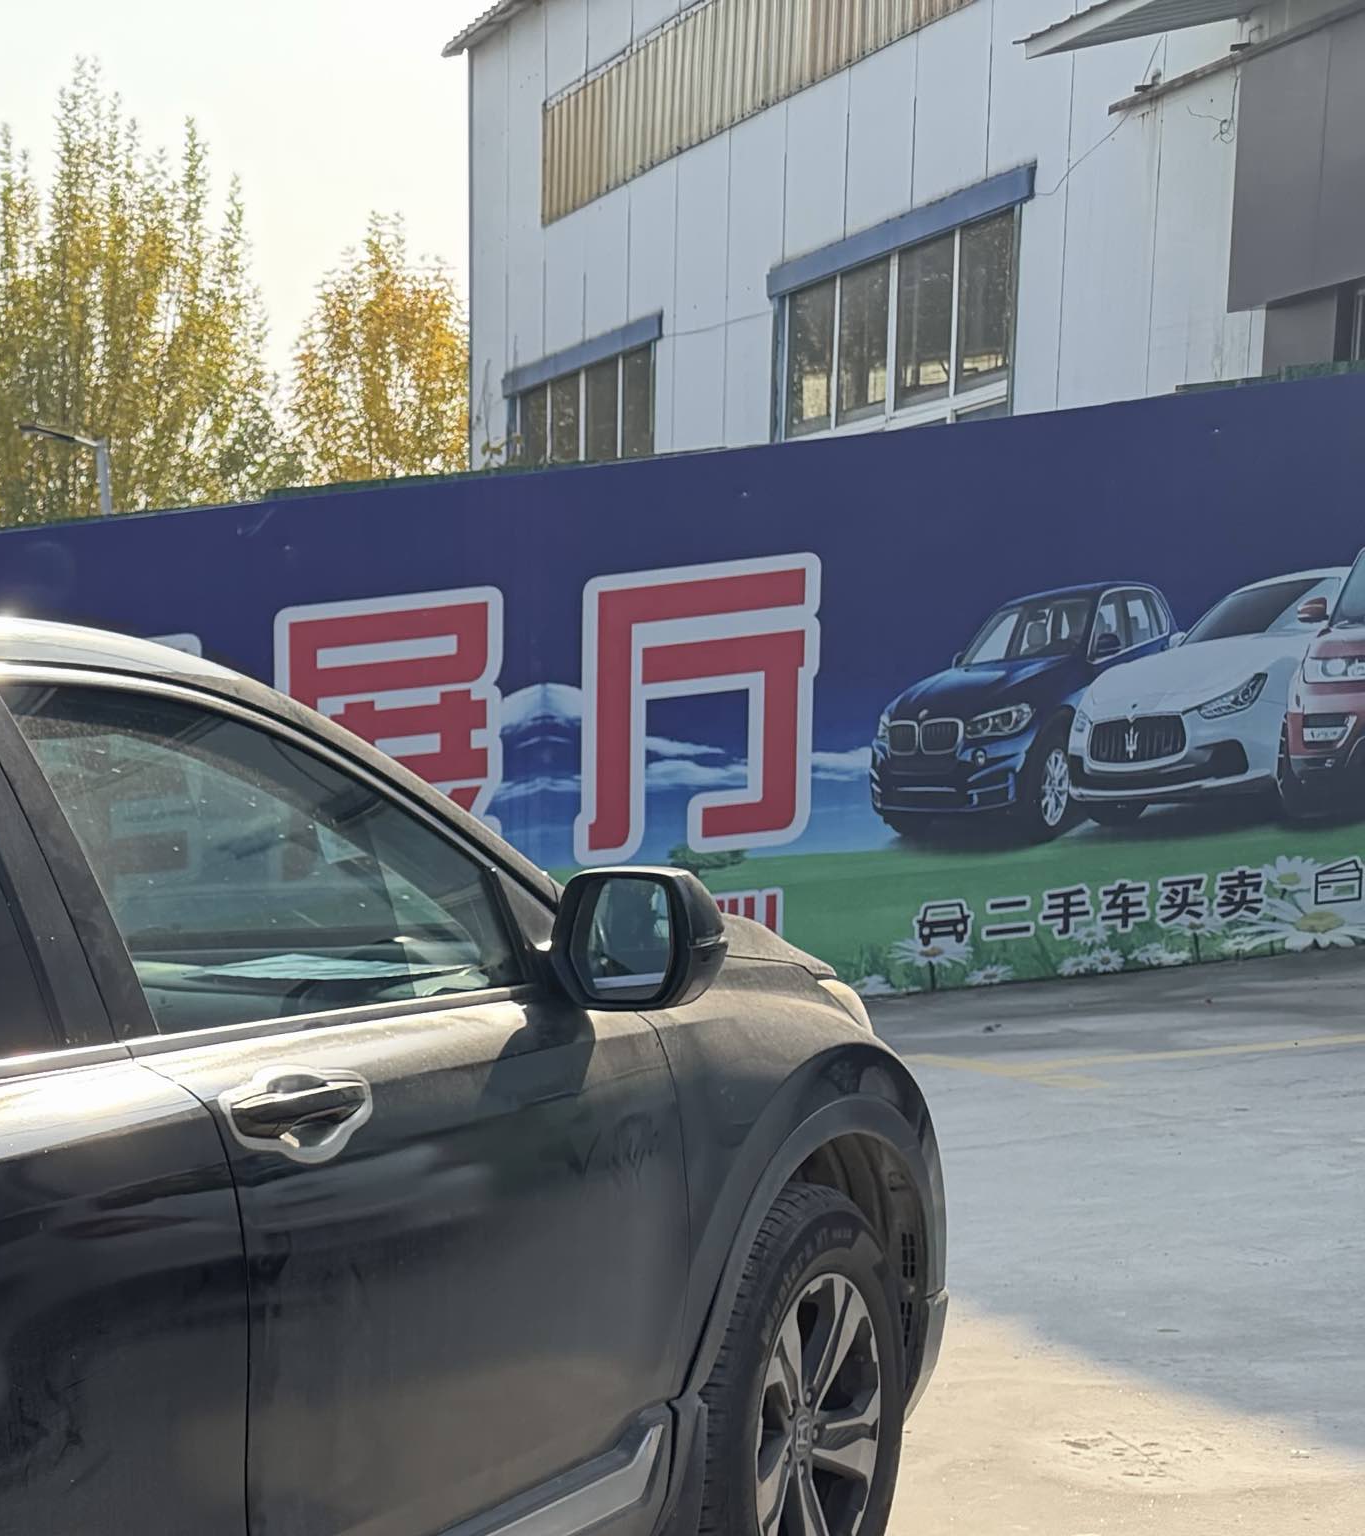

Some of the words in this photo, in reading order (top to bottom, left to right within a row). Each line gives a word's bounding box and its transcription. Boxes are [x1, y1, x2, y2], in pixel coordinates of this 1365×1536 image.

[985, 870, 1264, 937] 二手车买卖
